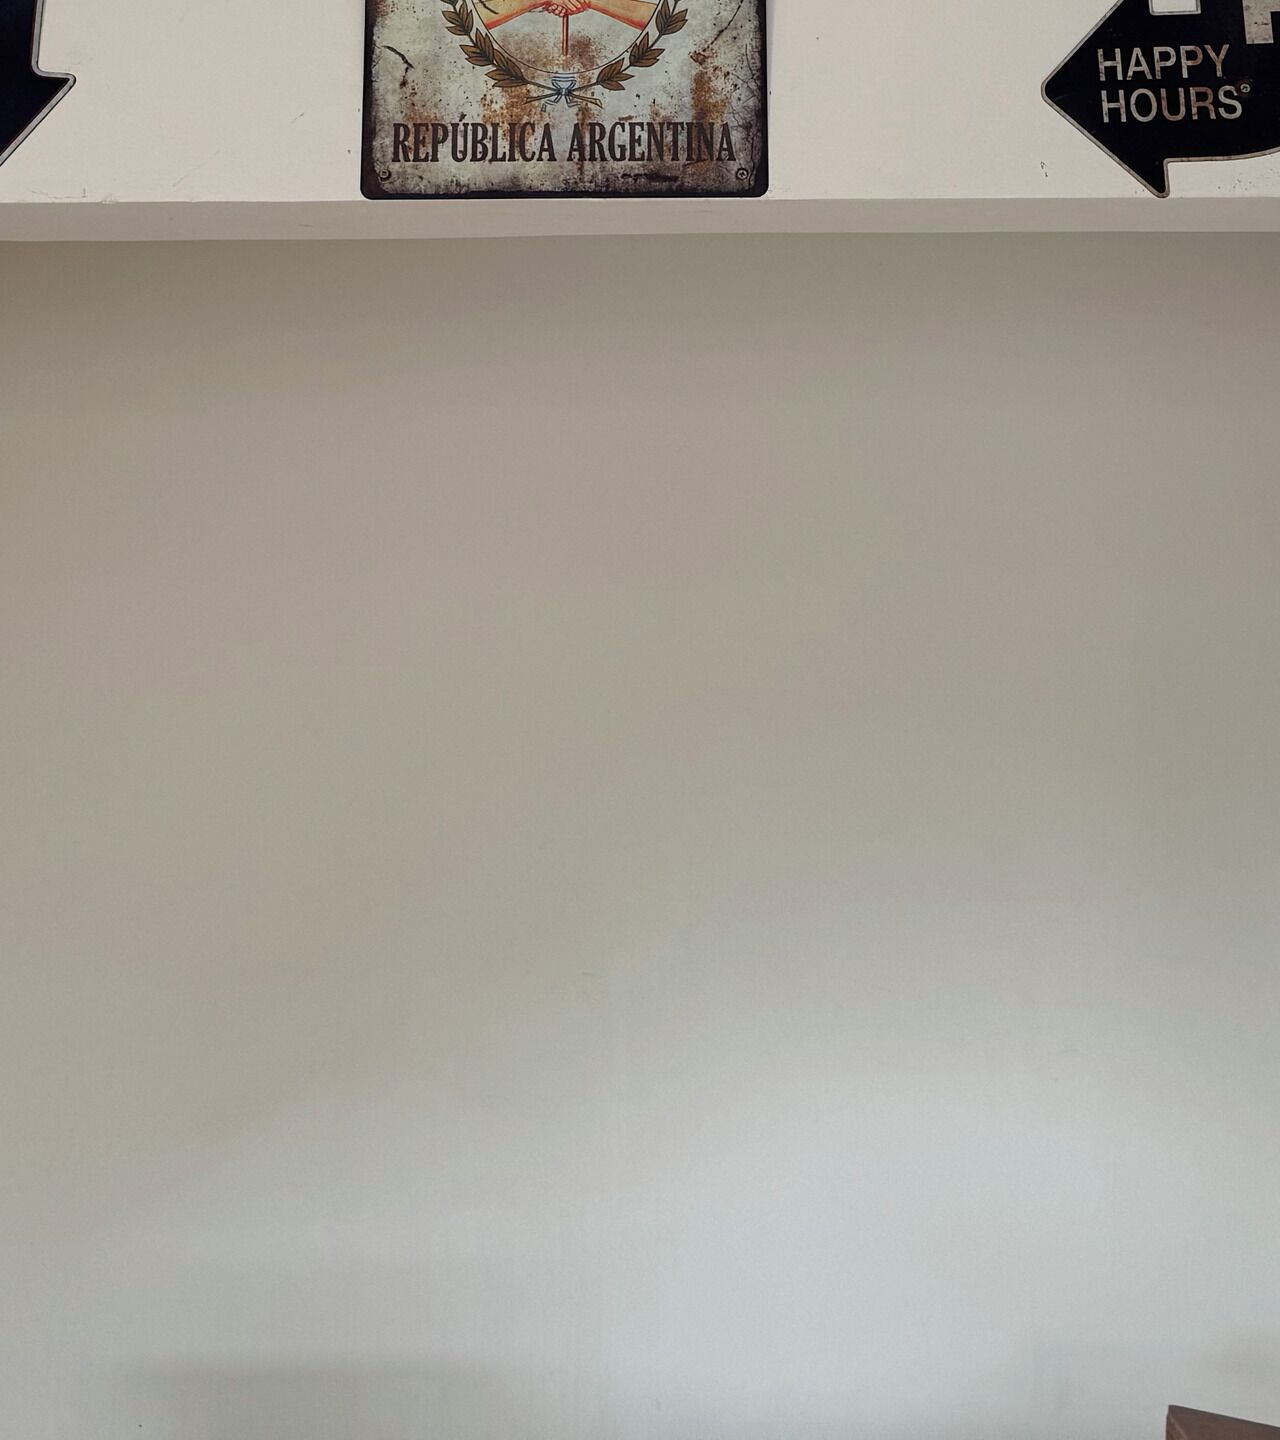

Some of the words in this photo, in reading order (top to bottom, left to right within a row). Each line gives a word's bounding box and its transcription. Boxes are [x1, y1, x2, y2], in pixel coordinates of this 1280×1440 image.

[1097, 44, 1230, 82] HAPPY
[1100, 85, 1244, 124] HOURS
[391, 112, 557, 163] REPÚBLICA
[566, 121, 737, 163] ARGENTINA
